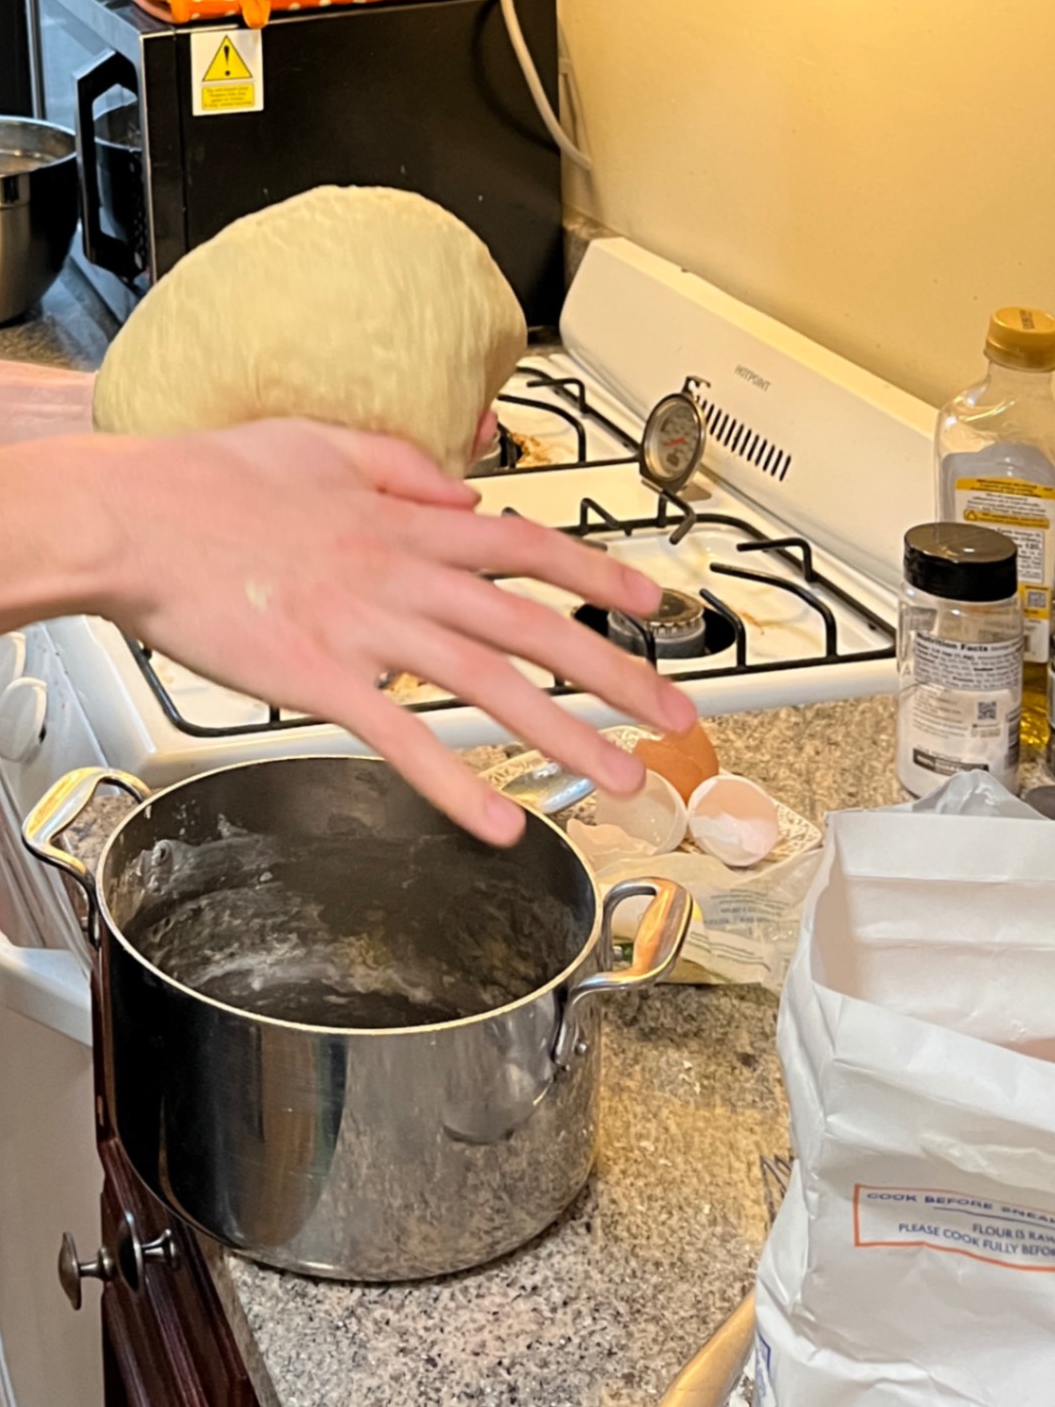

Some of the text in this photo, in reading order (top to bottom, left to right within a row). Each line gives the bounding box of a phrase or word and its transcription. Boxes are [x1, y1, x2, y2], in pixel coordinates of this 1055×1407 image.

[961, 643, 988, 652] Facts
[866, 1192, 917, 1203] COOK
[924, 1195, 993, 1210] BEFORE
[898, 1223, 940, 1237] PLEASE
[943, 1228, 981, 1245] COOK
[982, 1240, 1020, 1255] FULLY
[972, 1223, 1012, 1239] FLOUR
[1015, 1229, 1025, 1239] IS
